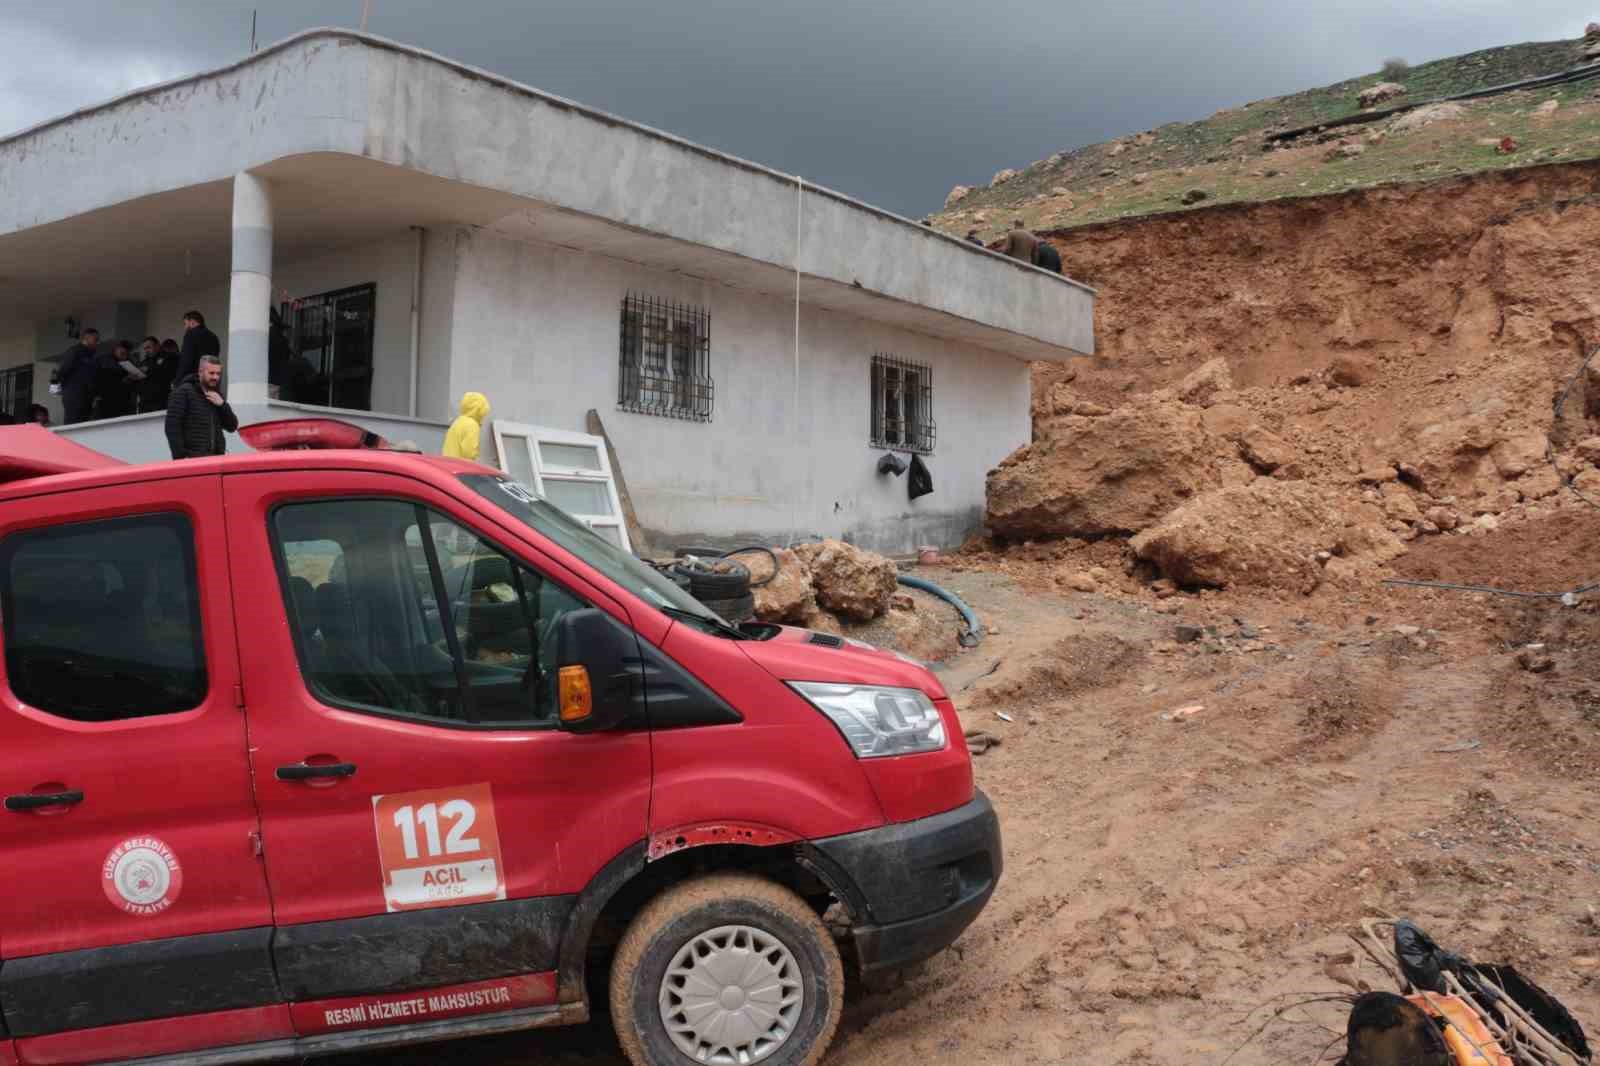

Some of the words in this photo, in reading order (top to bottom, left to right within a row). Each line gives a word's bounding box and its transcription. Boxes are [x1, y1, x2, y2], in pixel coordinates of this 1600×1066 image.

[393, 799, 480, 859] 112
[423, 866, 467, 887] ACİL
[325, 1003, 367, 1025] RESMİ
[368, 999, 427, 1020] HİZMETE
[428, 987, 510, 1013] MAHSUSTUR
